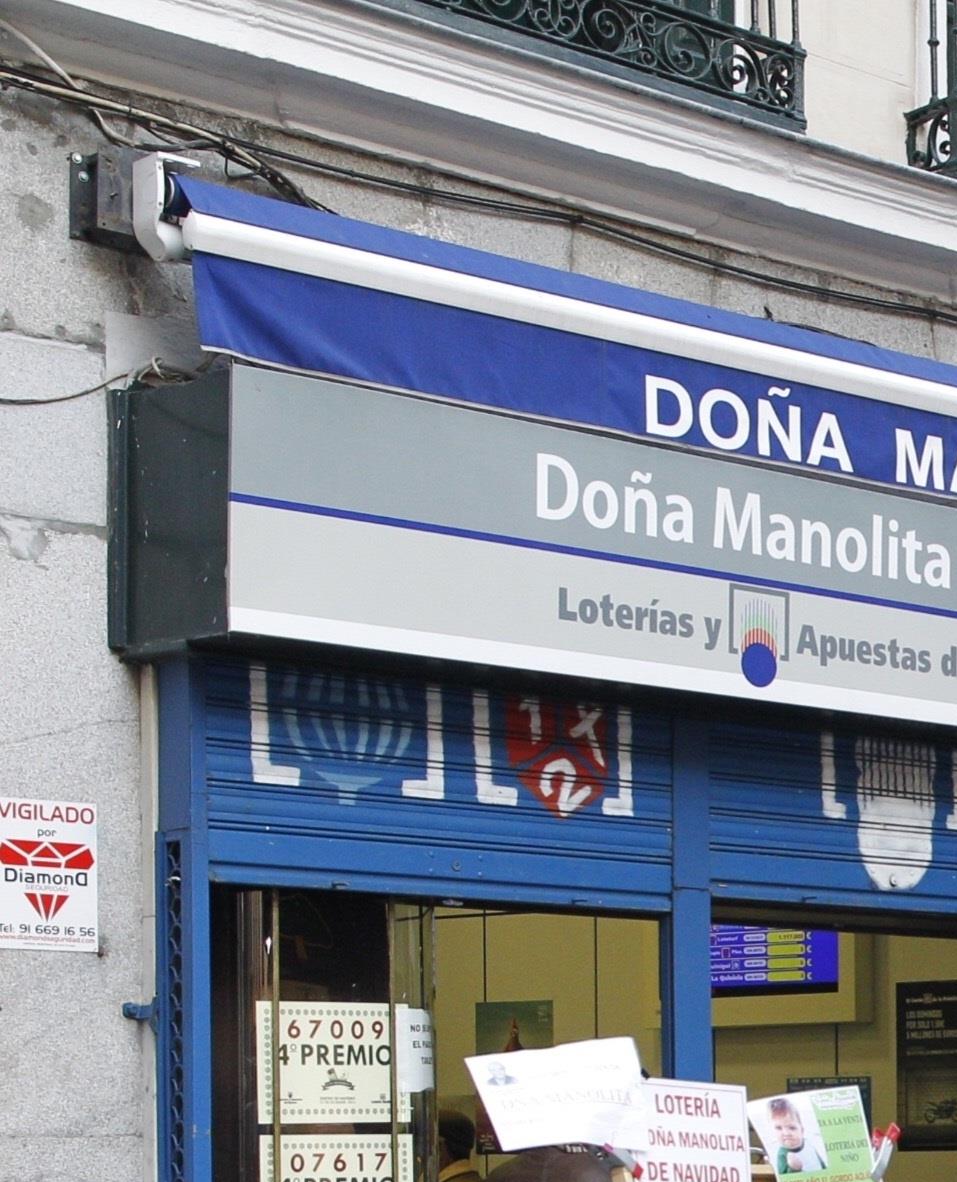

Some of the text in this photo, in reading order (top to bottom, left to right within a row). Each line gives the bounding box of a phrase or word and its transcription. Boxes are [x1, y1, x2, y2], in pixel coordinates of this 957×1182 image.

[644, 374, 854, 474] DOÑA
[535, 452, 951, 589] Doña Manolita
[557, 586, 694, 638] Loterías
[704, 615, 722, 651] y
[797, 624, 931, 674] Apuestas
[0, 801, 95, 825] VIGILADO
[37, 828, 57, 838] por
[19, 924, 31, 934] 91
[35, 925, 60, 935] 669
[64, 926, 76, 936] 16
[79, 927, 96, 937] 56
[287, 1019, 384, 1039] 67009
[301, 1044, 391, 1066] PREMIO
[655, 1092, 721, 1119] LOTERÍA
[678, 1131, 745, 1152] MANOLITA
[290, 1153, 387, 1173] 07617
[647, 1161, 669, 1182] DE
